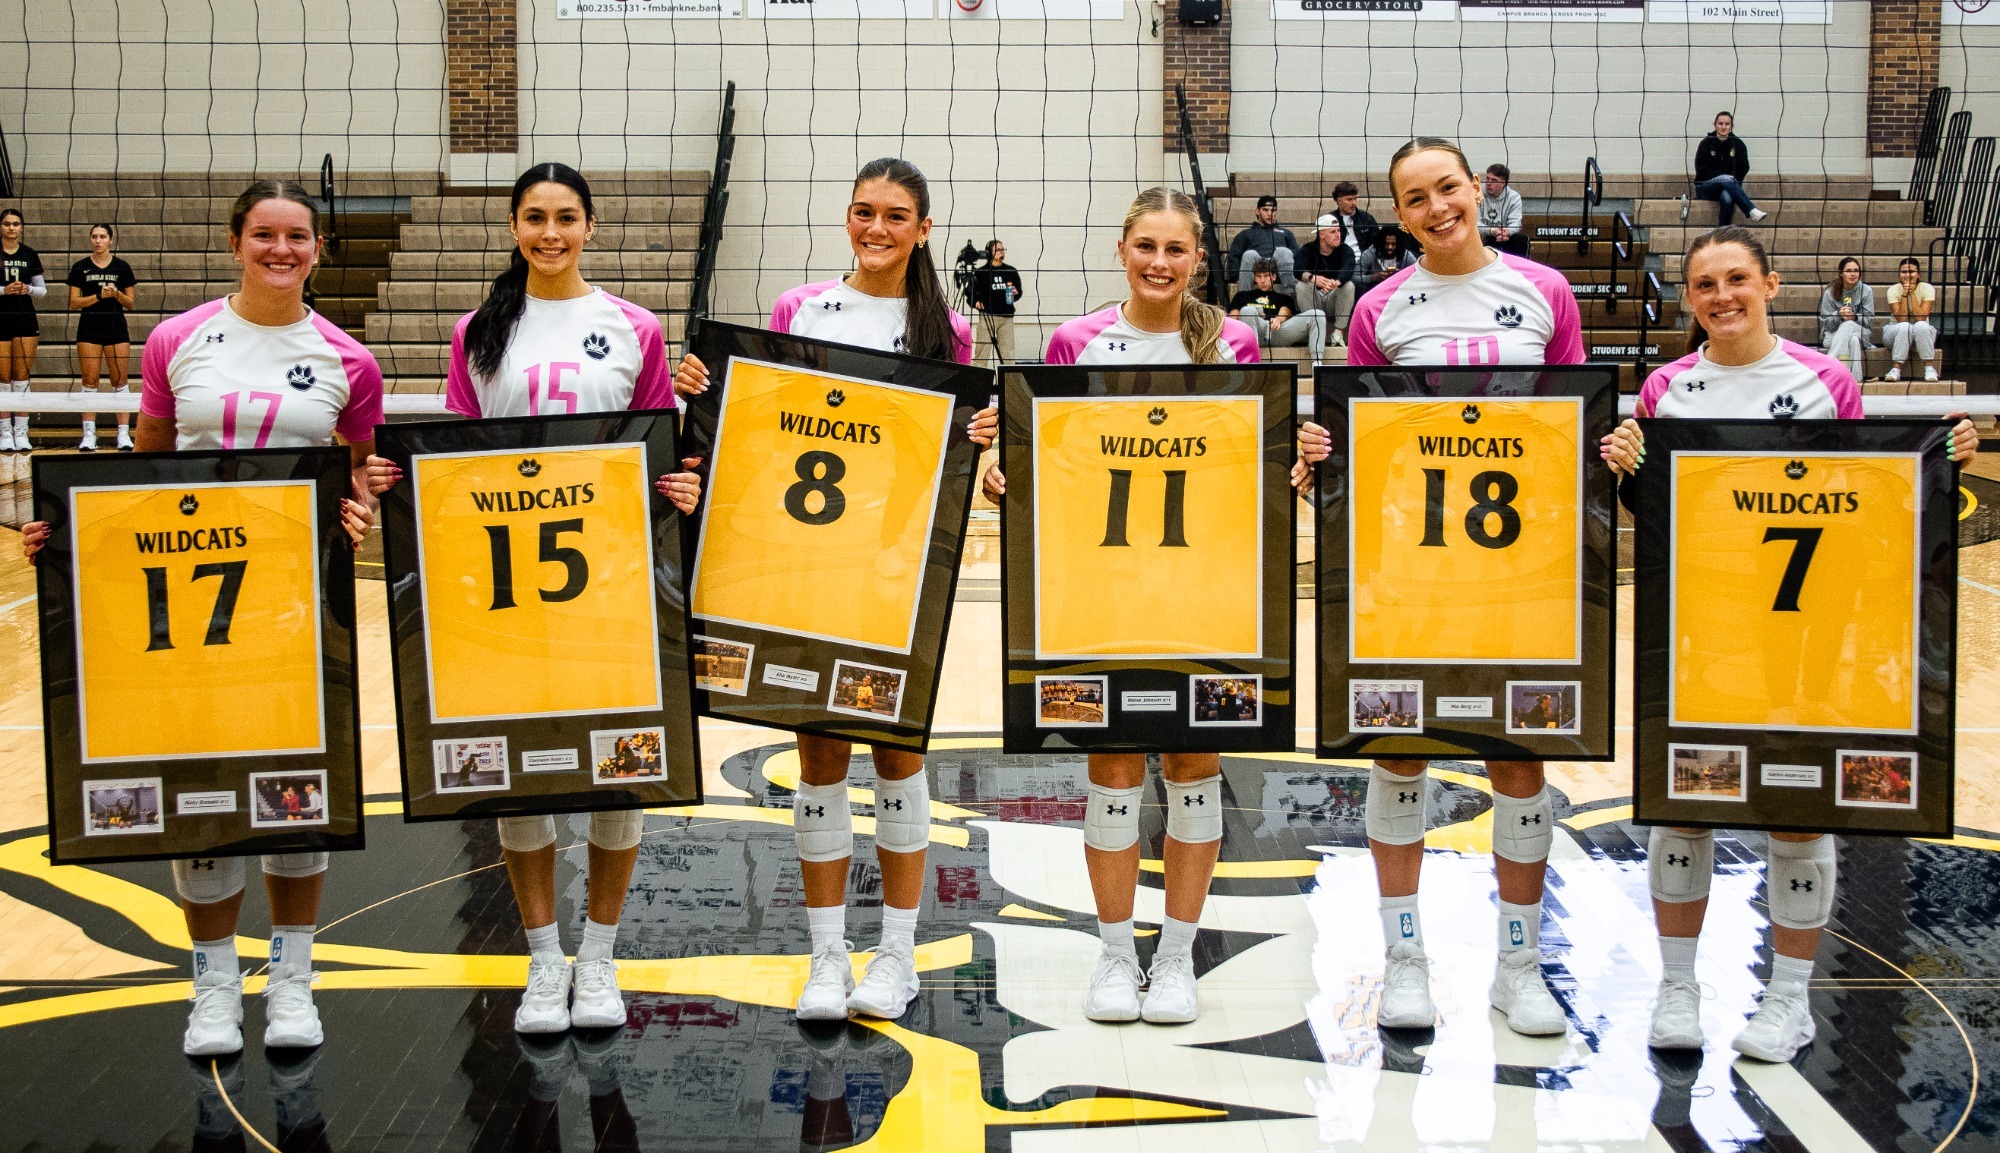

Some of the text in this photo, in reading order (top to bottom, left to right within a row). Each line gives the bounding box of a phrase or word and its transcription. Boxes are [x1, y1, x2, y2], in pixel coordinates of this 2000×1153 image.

[576, 4, 722, 12] 800.235.5331 fmbankne.bank
[1305, 1, 1419, 10] GROCERY STORE
[1702, 7, 1779, 17] 102 Main Street
[1536, 227, 1598, 236] STUDENT SECON
[1570, 284, 1597, 293] TUDENT
[1591, 346, 1626, 355] STUDENT
[523, 361, 581, 416] 15
[219, 390, 284, 450] 17
[780, 410, 881, 445] WILDCATS
[1100, 434, 1207, 458] WILDCATS
[1418, 435, 1524, 458] WILDCATS
[470, 482, 595, 513] WILDCATS
[784, 449, 846, 526] 8
[1731, 489, 1859, 515] WILDCATS
[1098, 468, 1191, 547] 11
[1417, 468, 1522, 549] 18
[135, 526, 248, 554] WILDCATS
[482, 517, 589, 611] 15
[1761, 526, 1825, 612] 7
[141, 560, 248, 652] 17
